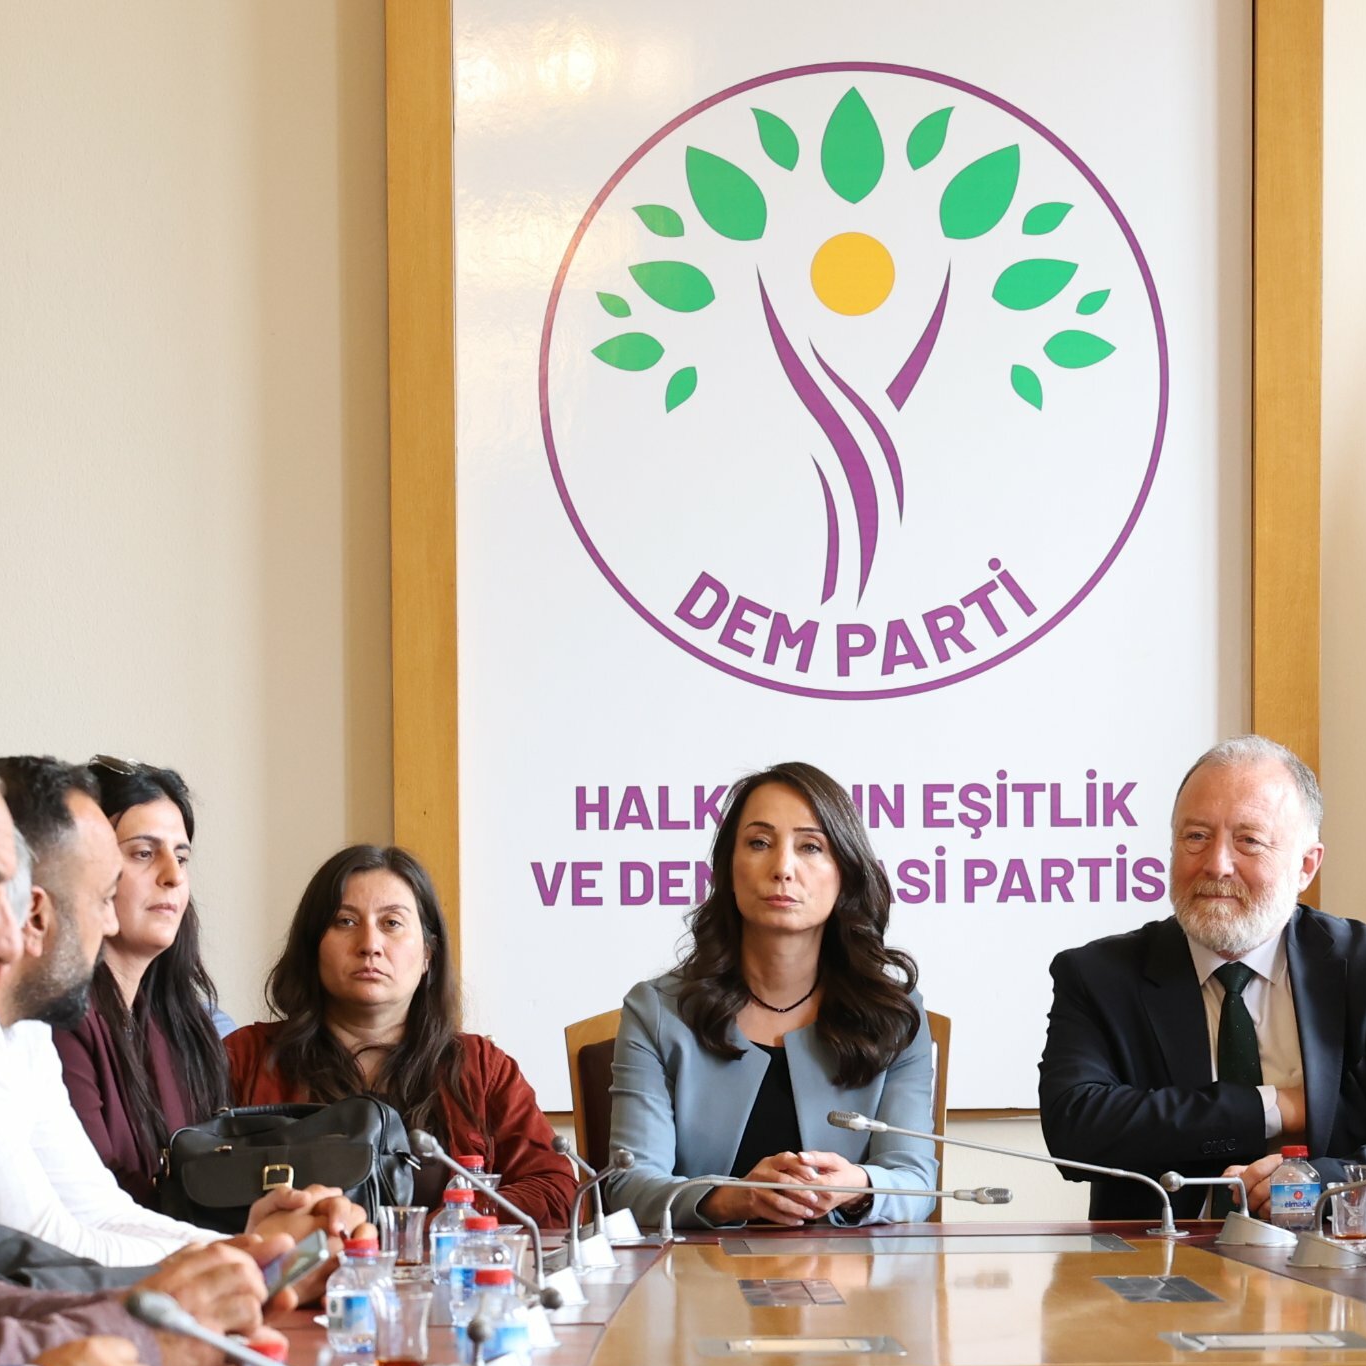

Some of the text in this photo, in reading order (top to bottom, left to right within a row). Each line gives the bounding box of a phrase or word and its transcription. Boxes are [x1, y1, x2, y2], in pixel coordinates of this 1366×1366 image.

[674, 557, 1038, 677] DEM PARTİ
[575, 769, 1138, 840] HALKIN EŞİTLİK
[531, 861, 604, 906] VE
[963, 844, 1166, 903] PARTİS
